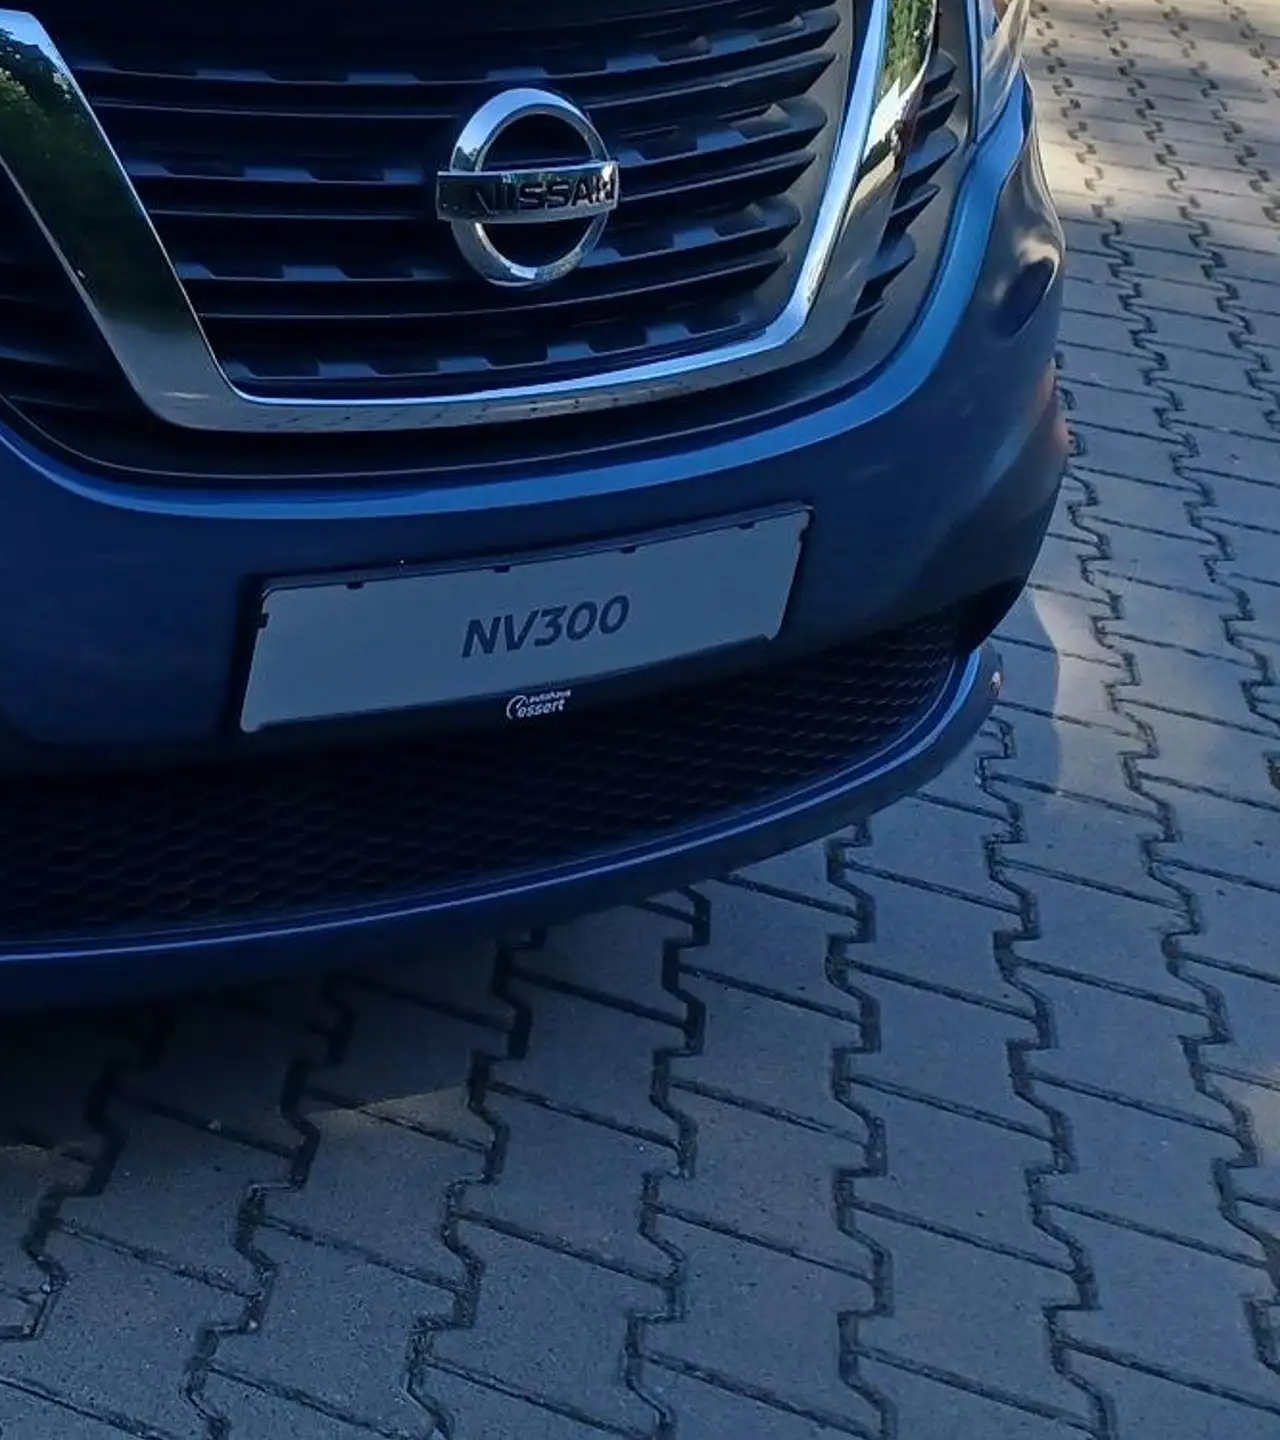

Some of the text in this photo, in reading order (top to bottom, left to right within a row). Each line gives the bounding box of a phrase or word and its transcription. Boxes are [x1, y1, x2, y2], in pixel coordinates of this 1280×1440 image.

[467, 171, 615, 214] NISSAN
[462, 595, 630, 658] NV300
[517, 698, 565, 718] essert
